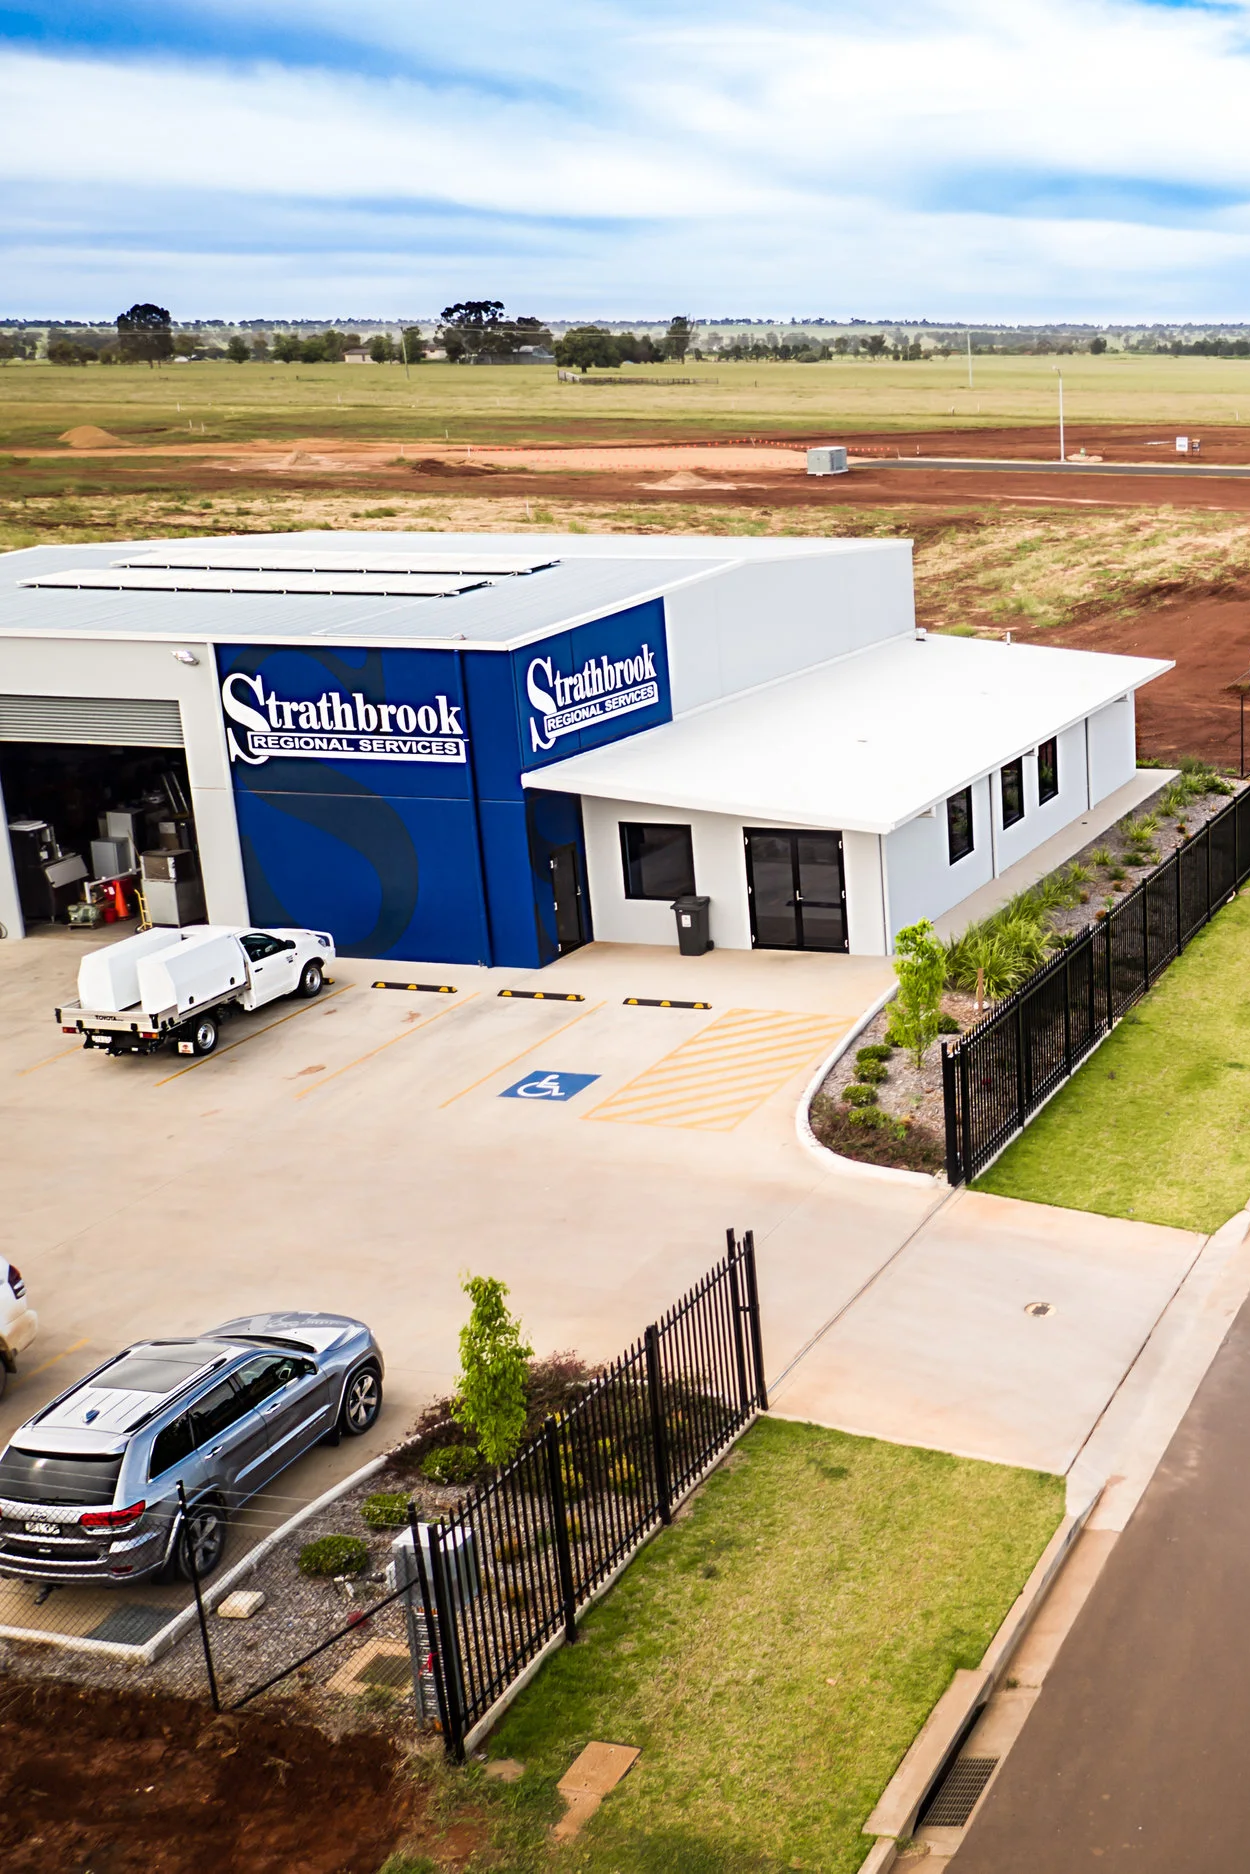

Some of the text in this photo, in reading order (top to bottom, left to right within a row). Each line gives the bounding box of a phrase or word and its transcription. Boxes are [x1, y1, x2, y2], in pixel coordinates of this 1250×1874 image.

[221, 672, 464, 765] Strathbrook
[526, 643, 658, 752] Strathbrook
[546, 685, 655, 732] REGIONAL SERVICES
[252, 735, 458, 756] REGIONAL SERVICES
